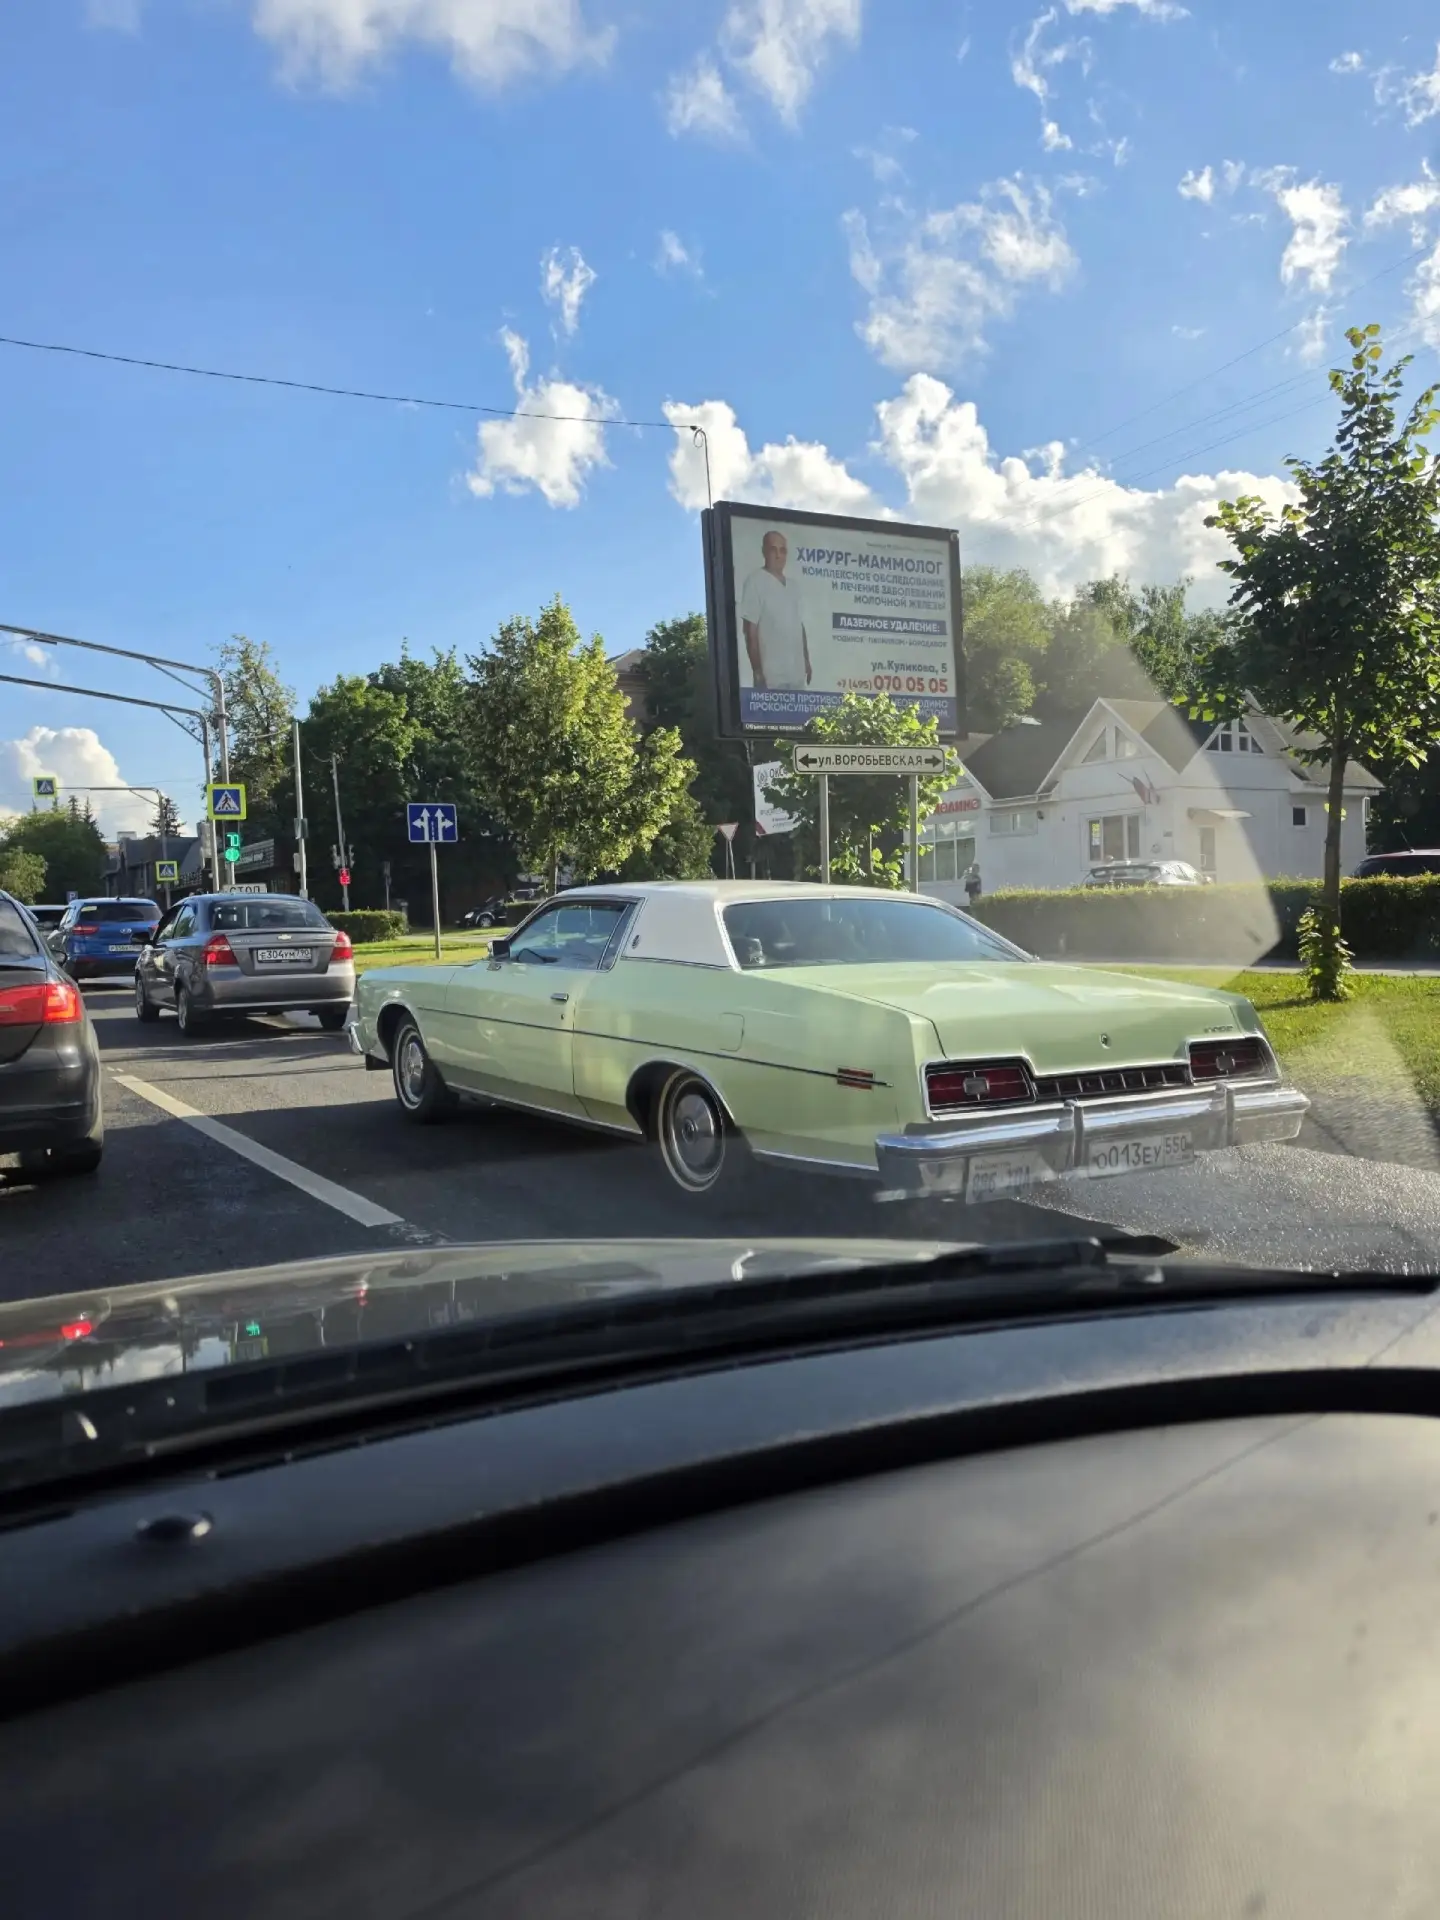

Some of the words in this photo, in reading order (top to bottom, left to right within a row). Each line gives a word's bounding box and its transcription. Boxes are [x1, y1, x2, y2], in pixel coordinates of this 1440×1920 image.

[796, 547, 943, 575] ХИРУРГ-МАММОЛОГ
[802, 566, 871, 582] КОМПЛЕКСНОЕ
[872, 574, 945, 588] ОБСЛЕДОВАНИЕ
[831, 581, 838, 590] И
[840, 582, 880, 594] ЛЕЧЕНИЕ
[881, 586, 945, 599] ЗАБОЛЕВАНИЙ
[854, 595, 906, 609] МОЛОЧНОЙ
[908, 600, 946, 610] ЖЕЛЕЗЫ
[839, 616, 889, 630] ЛАЗЕРНОЕ
[889, 619, 940, 633] УДАЛЕНИЕ:
[941, 663, 948, 673] 5
[874, 675, 901, 692] 070
[905, 677, 925, 692] 05
[929, 677, 949, 693] 05
[751, 691, 796, 703] ИМЕЮТСЯ
[229, 885, 261, 894] СТОП
[1095, 1141, 1161, 1170] О013ЕУ
[1164, 1135, 1188, 1156] 550
